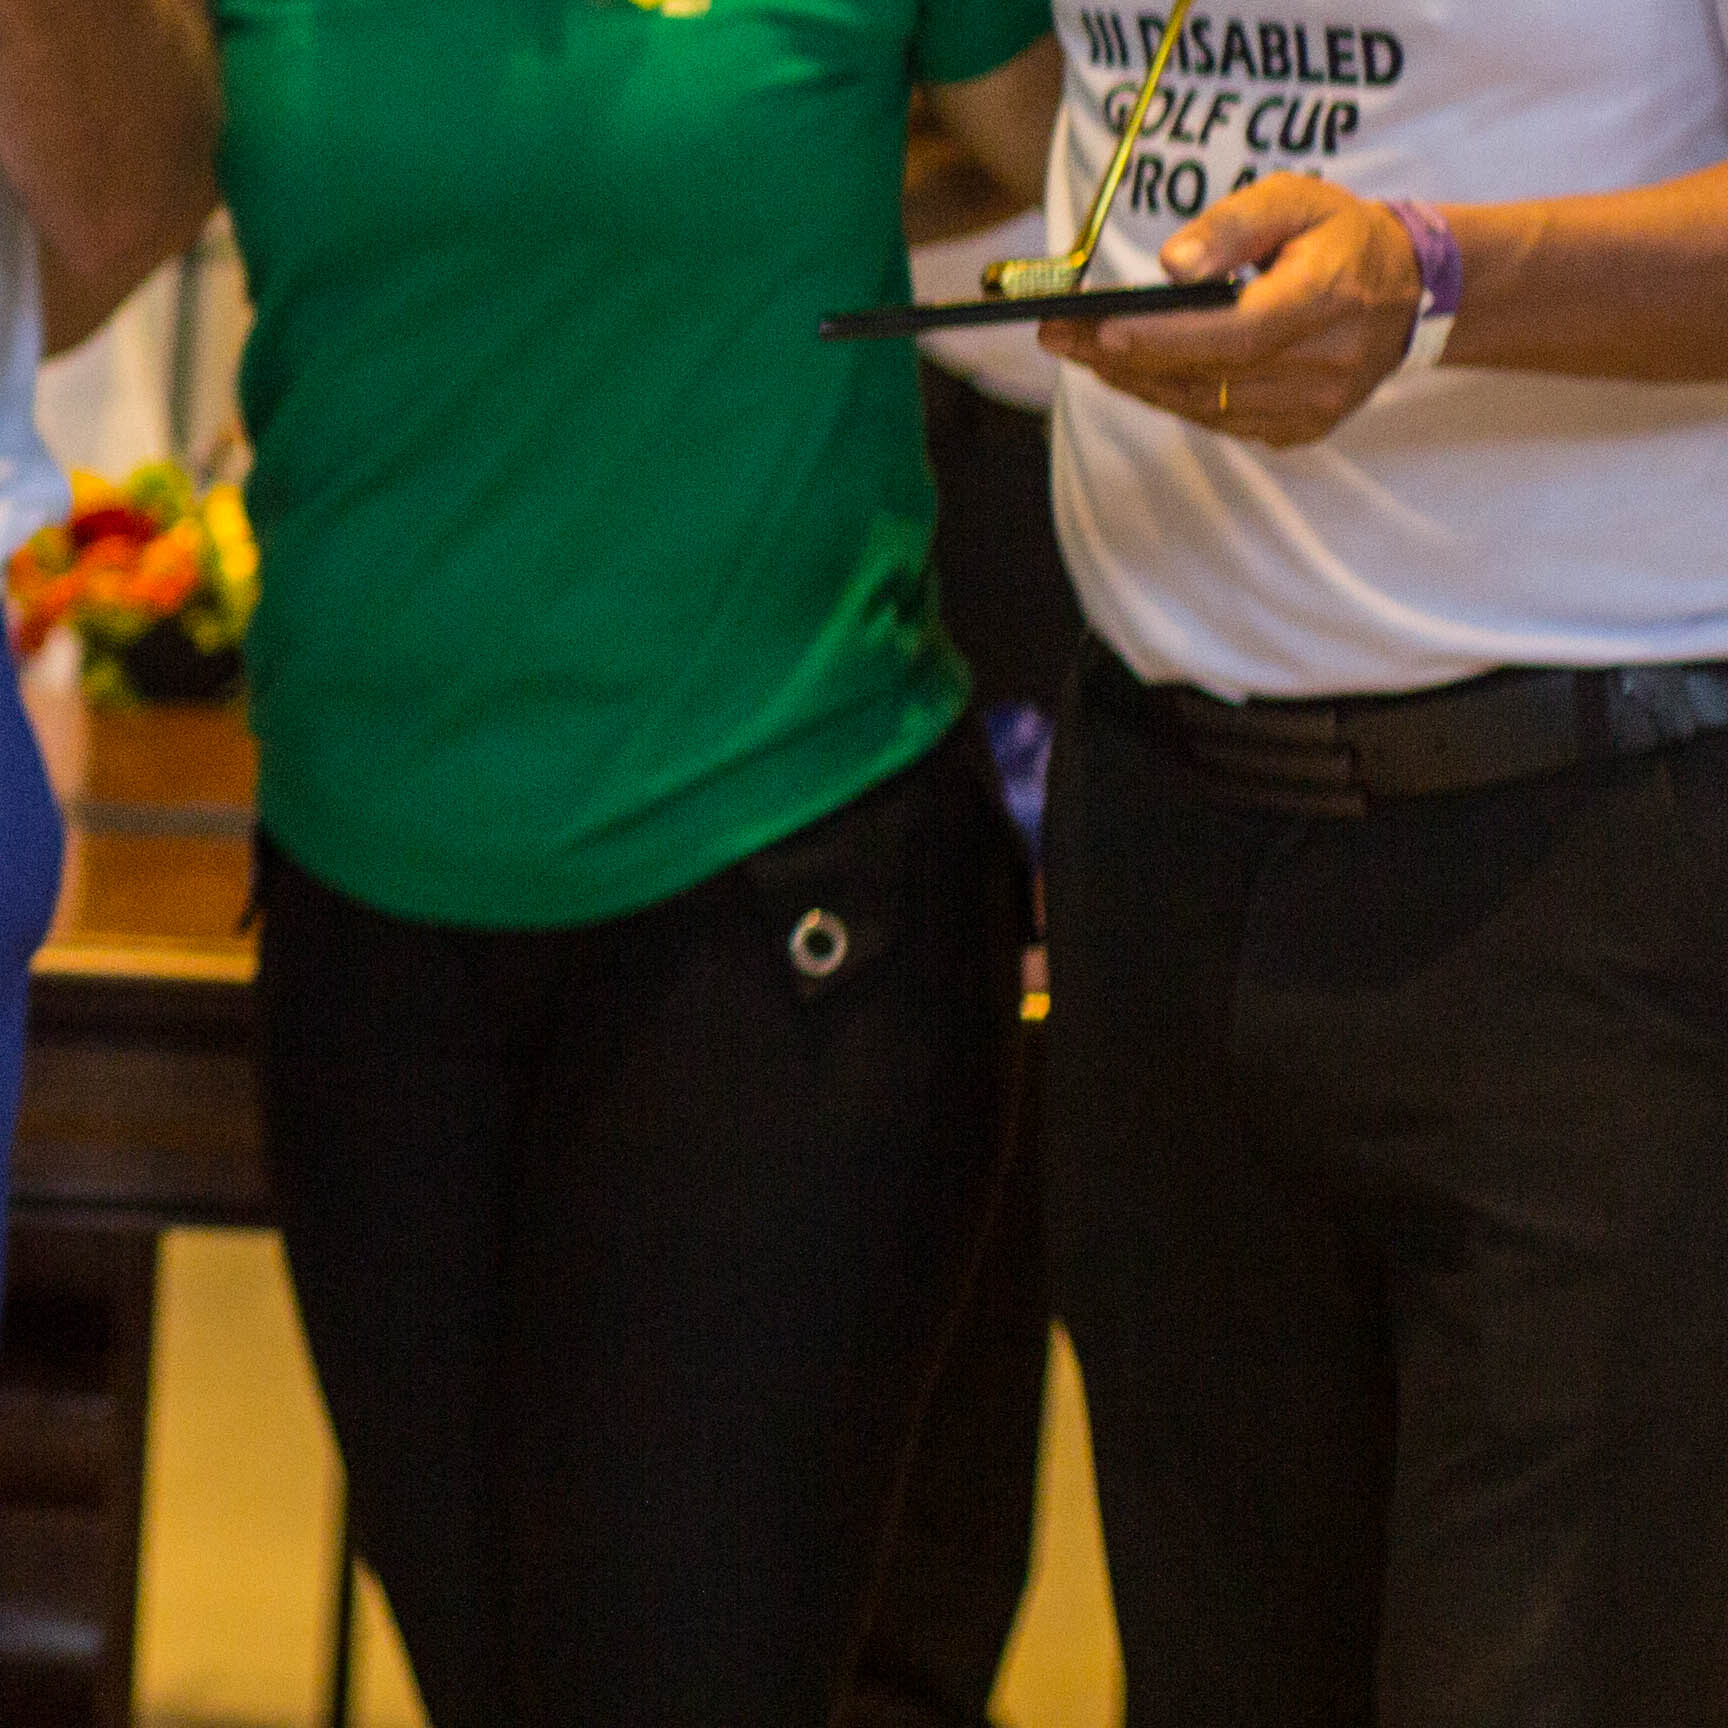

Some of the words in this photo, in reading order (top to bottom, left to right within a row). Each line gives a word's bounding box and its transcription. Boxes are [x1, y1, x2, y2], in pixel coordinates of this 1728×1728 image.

[1080, 8, 1131, 70] III
[1137, 12, 1405, 87] DISABLED
[1104, 79, 1242, 147] GOLF
[1244, 93, 1363, 158] CUP
[1122, 151, 1209, 219] RO
